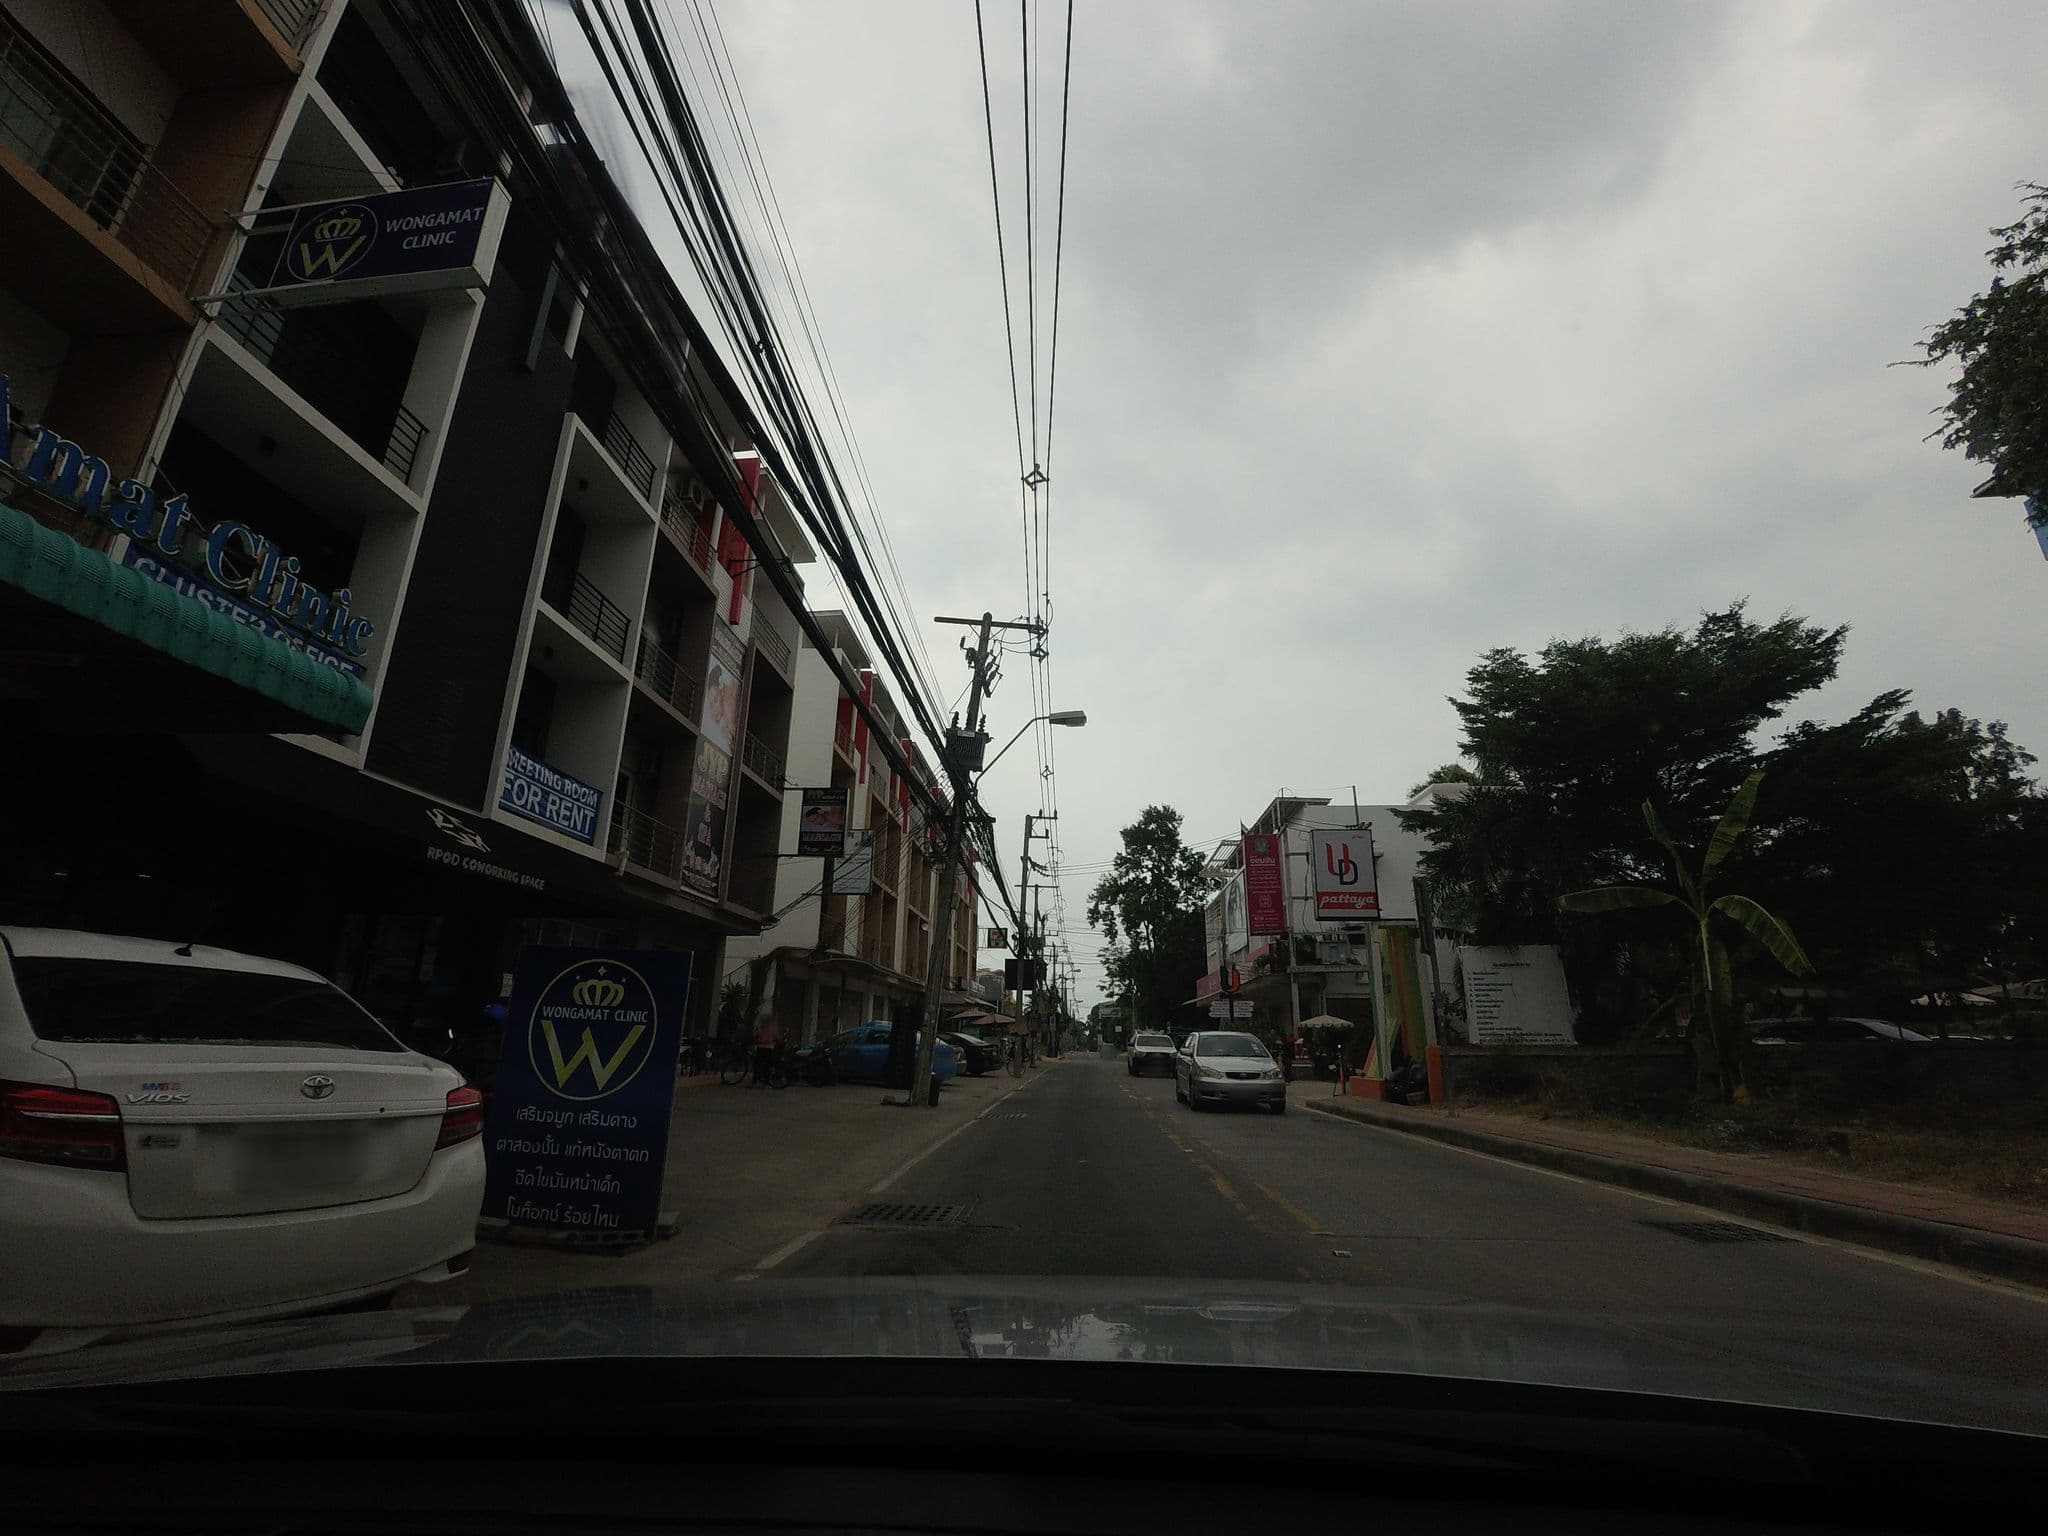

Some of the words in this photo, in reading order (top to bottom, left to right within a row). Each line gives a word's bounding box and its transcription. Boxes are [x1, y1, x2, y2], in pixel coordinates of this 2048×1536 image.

[386, 207, 485, 233] WONGAMAT
[402, 231, 457, 250] CLINIC
[205, 520, 374, 656] Clinic
[507, 749, 562, 791] MEETING
[564, 779, 599, 808] ROOM
[503, 772, 542, 815] FOR
[545, 793, 595, 835] RENT
[426, 846, 461, 866] RPOD
[462, 857, 519, 884] COWORKING
[519, 875, 545, 891] SPACE
[1320, 893, 1376, 909] pattaya
[542, 1006, 610, 1021] WONGAMAT
[614, 1009, 649, 1023] CLINIC
[126, 1092, 192, 1104] VIOS
[516, 1106, 575, 1128] เสริมจมูก
[579, 1109, 638, 1129] เสริมคาง
[496, 1133, 560, 1155] ตาสองชั้น
[565, 1137, 649, 1163] แก้หนังตาตก
[514, 1165, 621, 1194] ฉีดไขมันหน้าเด็ก
[563, 1203, 620, 1229] ร้อยไหม
